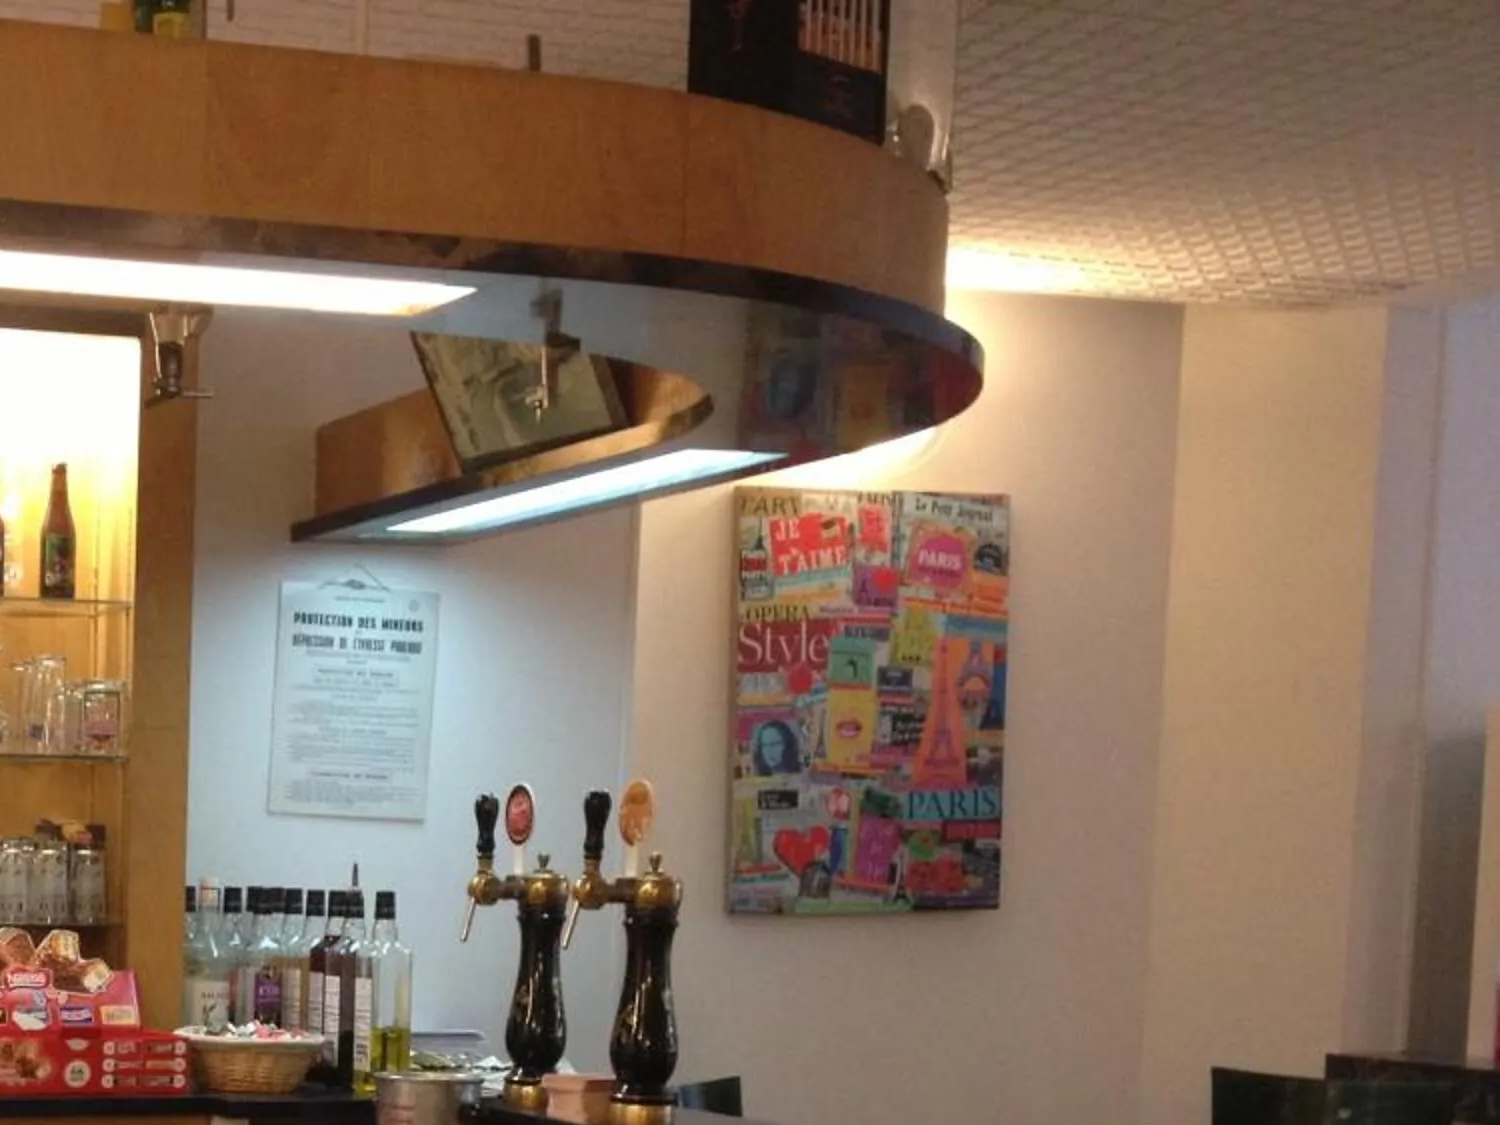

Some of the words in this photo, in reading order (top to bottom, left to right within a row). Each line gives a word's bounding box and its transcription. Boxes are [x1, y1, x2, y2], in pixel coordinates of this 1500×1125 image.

[294, 612, 353, 627] PROTECTION
[738, 619, 829, 671] Style
[908, 788, 997, 819] PARIS
